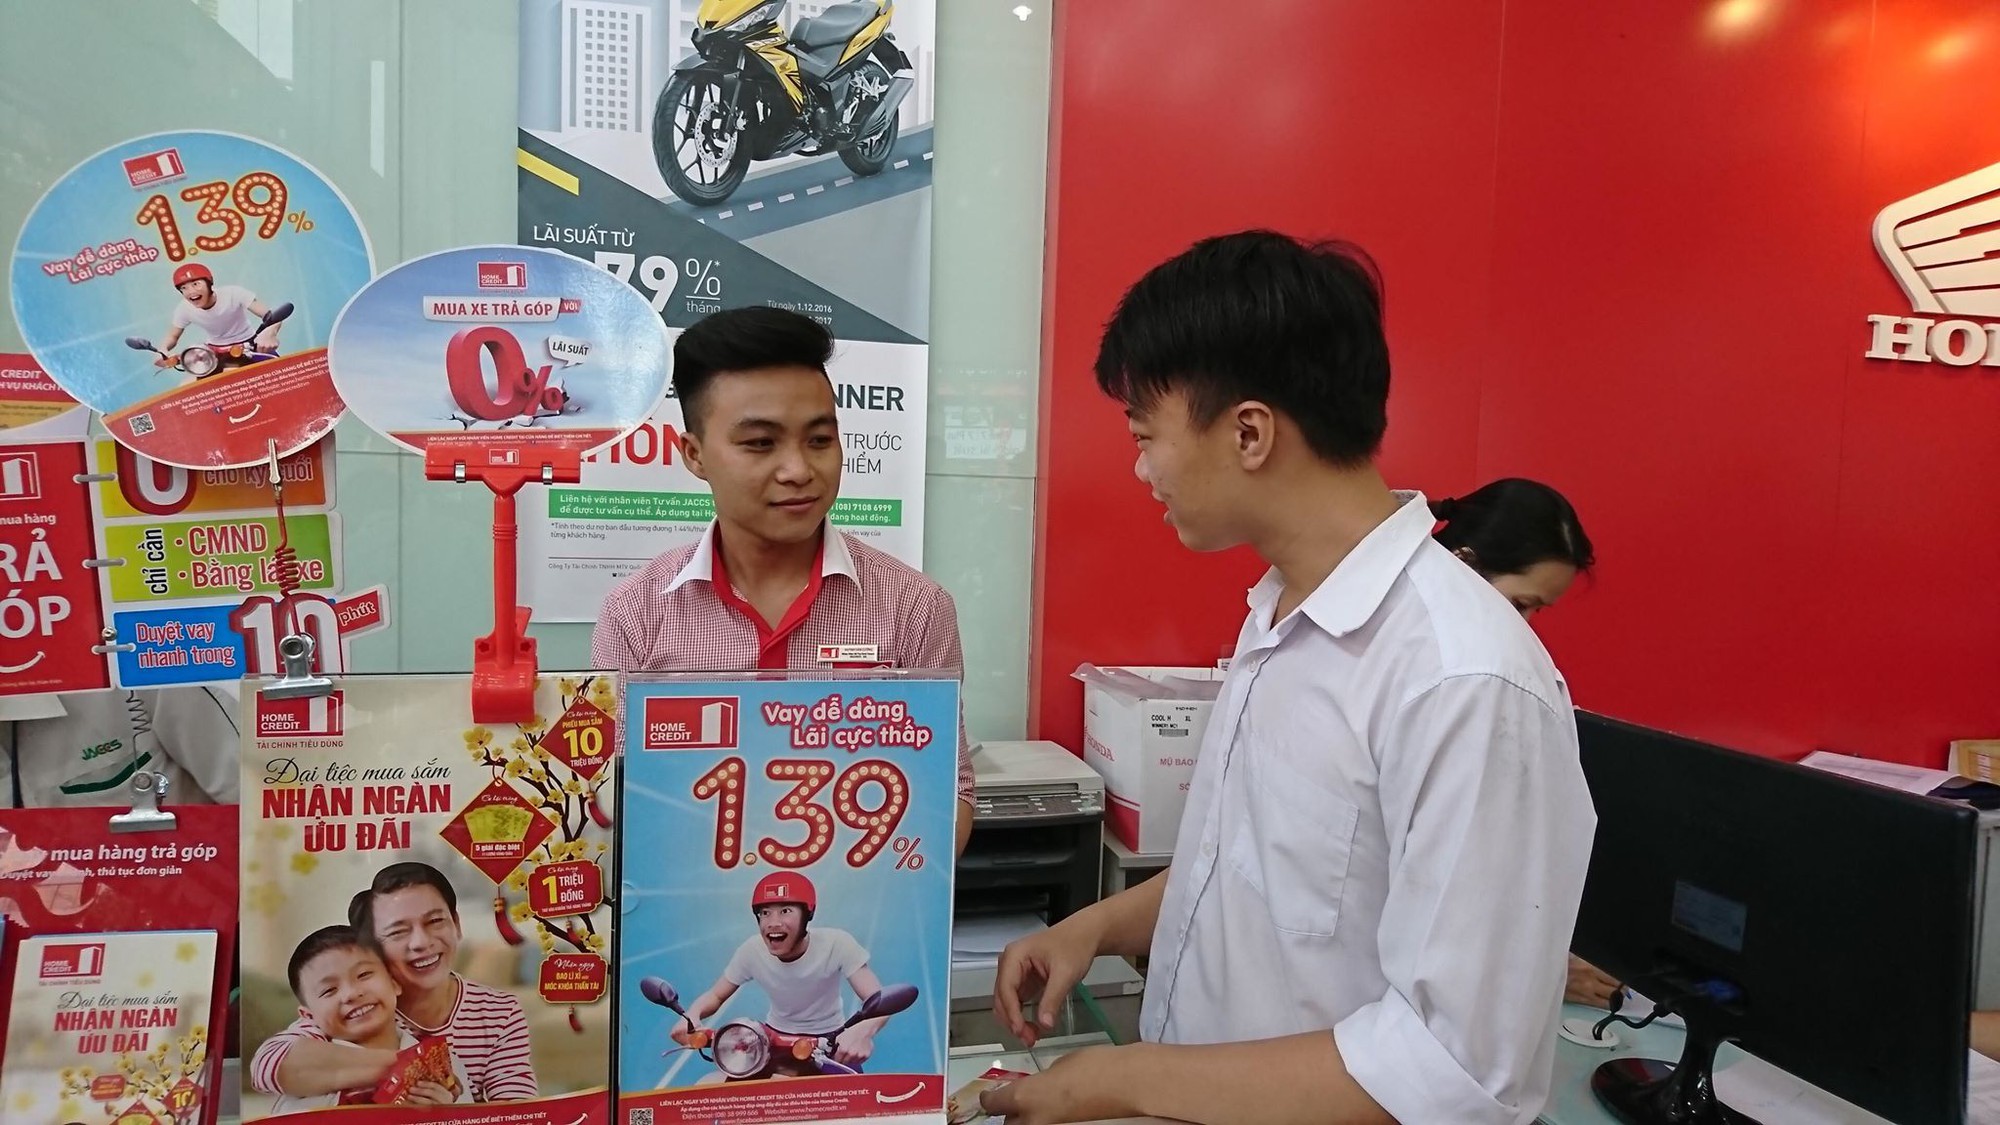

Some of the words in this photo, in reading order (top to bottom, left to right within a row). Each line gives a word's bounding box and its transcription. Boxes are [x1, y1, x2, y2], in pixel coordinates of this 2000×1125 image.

[533, 224, 560, 242] LÃI
[564, 223, 608, 246] SUẤT
[611, 226, 636, 247] TỪ
[43, 260, 73, 275] Vay
[98, 239, 137, 259] dàng
[96, 259, 122, 275] cực
[433, 302, 467, 316] MUA
[471, 302, 488, 316] XE
[492, 300, 521, 316] TRẢ
[524, 301, 554, 316] GÓP
[797, 302, 833, 313] 1.12.2016
[0, 368, 42, 379] CREDIT
[6, 381, 21, 392] VỤ
[22, 381, 56, 391] KHÁCH
[834, 384, 904, 411] NNER
[843, 431, 902, 451] TRƯỚC
[560, 494, 579, 504] Liên
[581, 494, 593, 505] hệ
[593, 495, 608, 505] với
[609, 496, 631, 505] nhân
[632, 496, 651, 506] viên
[682, 499, 710, 507] JACCS
[852, 503, 872, 511] 7108
[873, 504, 893, 512] 6999
[24, 513, 57, 527] hàng
[559, 505, 572, 514] để
[572, 506, 594, 516] được
[624, 508, 635, 517] cụ
[655, 507, 667, 518] Áp
[668, 508, 690, 519] dụng
[850, 513, 868, 522] hoạt
[138, 527, 164, 562] cần
[188, 523, 268, 557] CMND
[141, 565, 168, 595] chỉ
[191, 557, 254, 592] Bằng
[338, 600, 376, 626] phút
[135, 622, 184, 649] Duyệt
[186, 622, 216, 643] vay
[138, 648, 189, 668] nhanh
[191, 645, 236, 668] trong
[260, 713, 295, 723] HOME
[764, 704, 806, 726] Vay
[812, 694, 842, 722] dễ
[848, 696, 904, 723] dàng
[260, 721, 301, 731] CREDIT
[649, 731, 692, 742] CREDIT
[650, 722, 686, 732] HOME
[793, 725, 827, 747] Lãi
[835, 723, 873, 750] cực
[879, 719, 931, 748] thấp
[562, 726, 603, 758] 10
[263, 757, 319, 786] Đại
[325, 761, 359, 786] tiệc
[362, 765, 406, 782] mua
[411, 757, 452, 780] sắm
[1174, 757, 1194, 767] BAO
[262, 783, 353, 820] NHẬN
[363, 781, 452, 816] NGÀN
[355, 816, 411, 852] ĐÃI
[51, 848, 93, 862] mua
[98, 844, 147, 863] hàng
[151, 842, 178, 861] trả
[181, 843, 218, 863] góp
[97, 866, 116, 876] thủ
[118, 867, 135, 879] tục
[136, 866, 157, 876] đơn
[158, 864, 183, 877] giản
[541, 875, 558, 905] 1
[558, 872, 584, 888] TRIỆU
[560, 888, 584, 903] ĐỒNG
[54, 1008, 115, 1032] NHẬN
[120, 1006, 178, 1030] NGÀN
